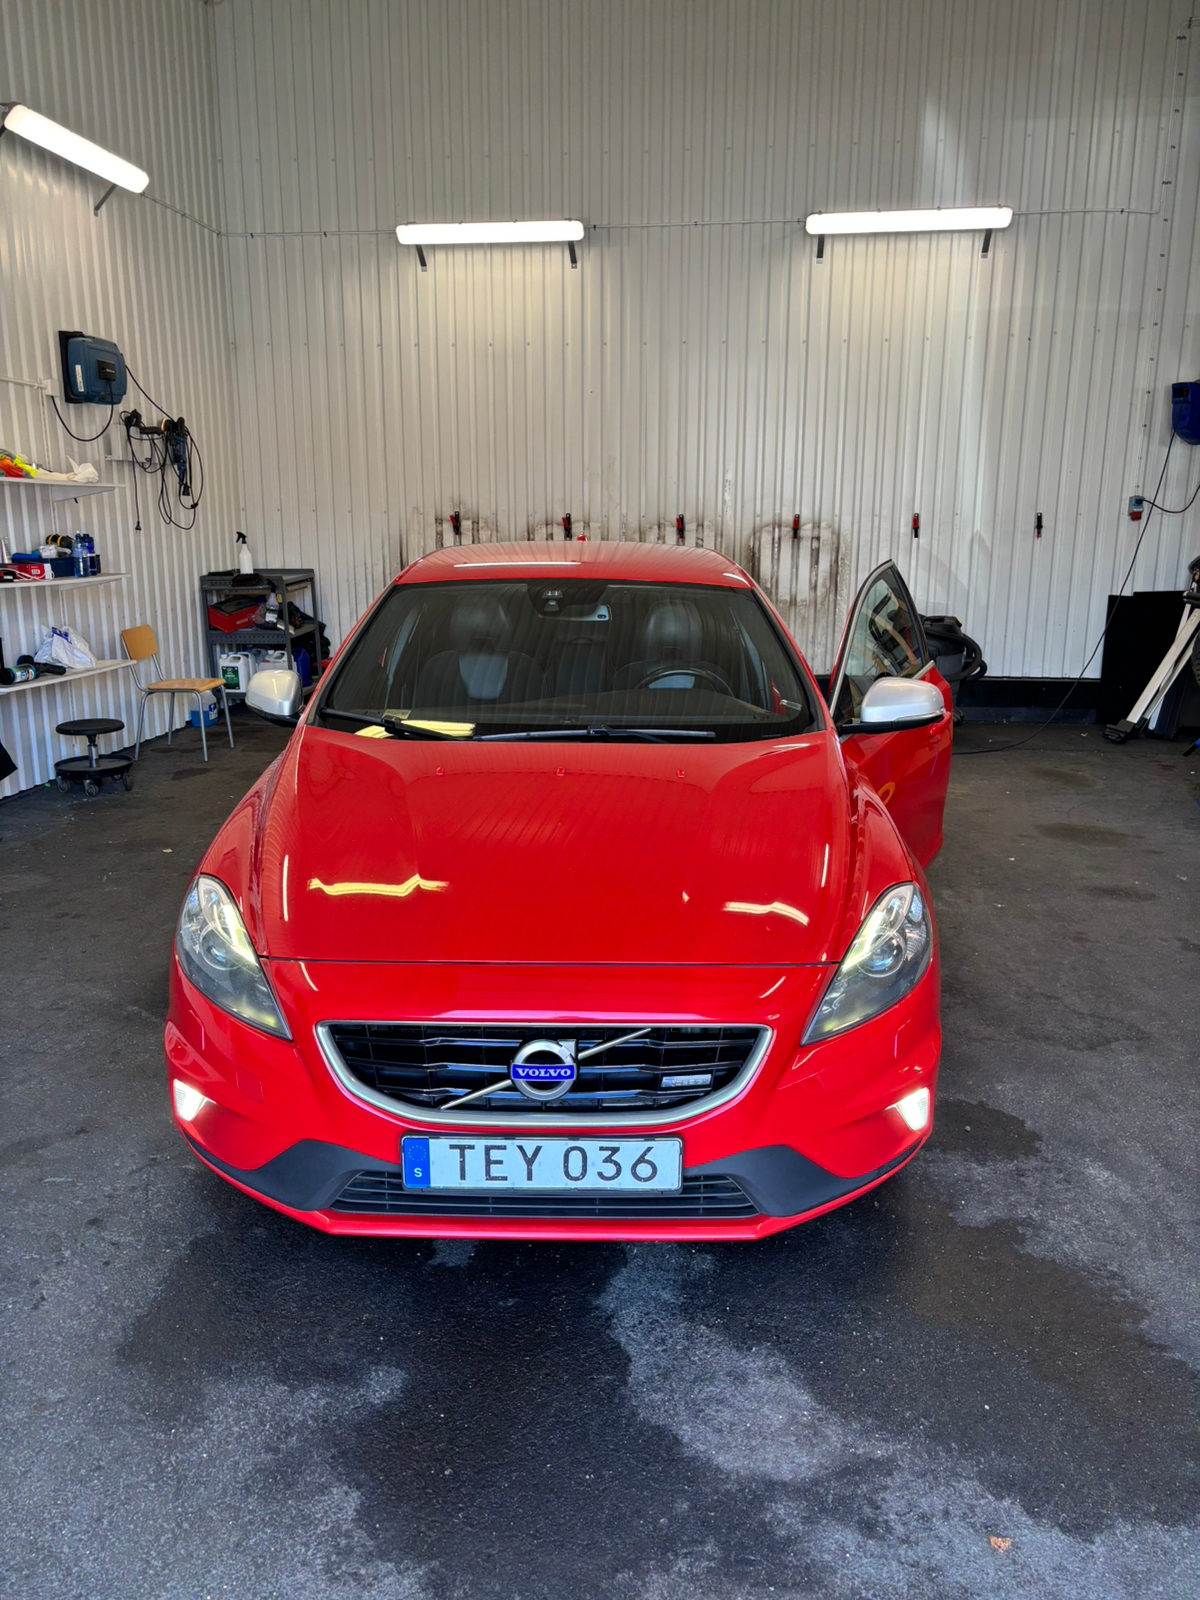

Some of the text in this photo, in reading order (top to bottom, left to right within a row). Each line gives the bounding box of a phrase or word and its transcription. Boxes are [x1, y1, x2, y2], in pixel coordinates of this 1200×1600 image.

[515, 1067, 572, 1077] VOLVO
[448, 1144, 658, 1183] TEY 036
[413, 1167, 423, 1178] S
